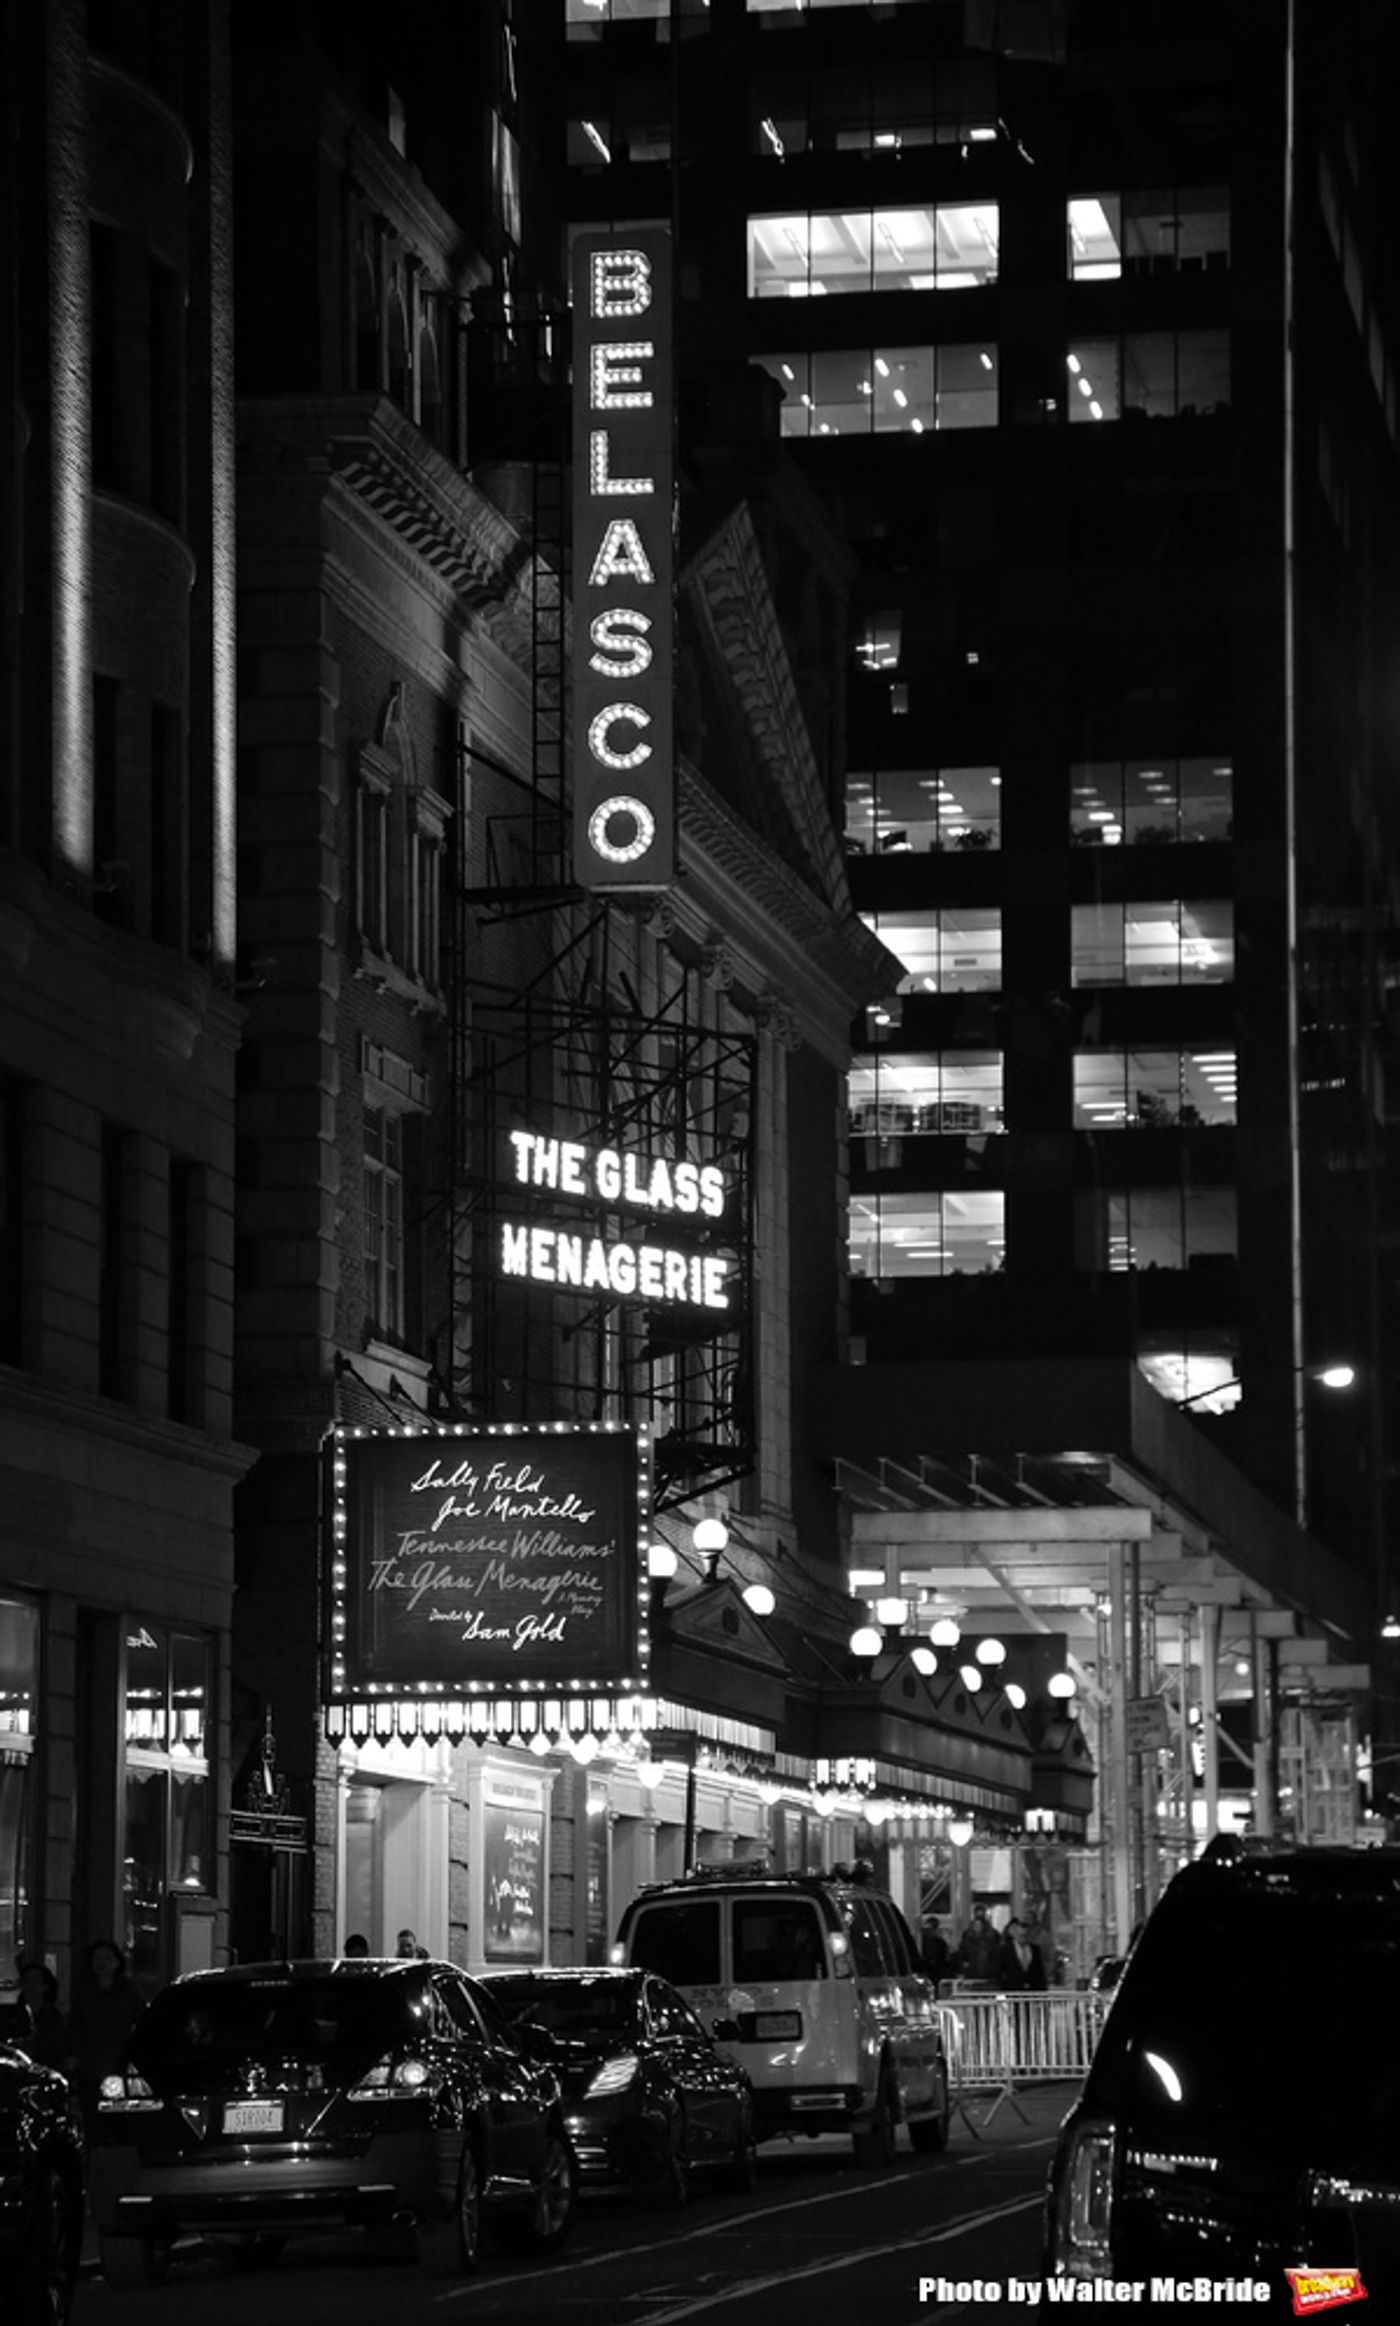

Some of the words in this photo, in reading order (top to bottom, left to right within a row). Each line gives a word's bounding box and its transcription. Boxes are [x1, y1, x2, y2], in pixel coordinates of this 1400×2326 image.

[588, 250, 655, 863] BELASCO
[510, 1130, 586, 1195] THE
[596, 1149, 724, 1217] GLASS
[502, 1223, 729, 1309] MENAGERIE
[411, 1459, 479, 1497] Sally
[483, 1462, 545, 1493] Field
[431, 1496, 481, 1532] Joe
[485, 1494, 597, 1523] Mantello
[397, 1530, 507, 1557] Tennessee
[368, 1557, 406, 1591] The
[408, 1561, 474, 1611] Glass
[475, 1559, 603, 1605] Menagerie
[462, 1611, 511, 1640] Sam
[512, 1612, 567, 1650] Gold
